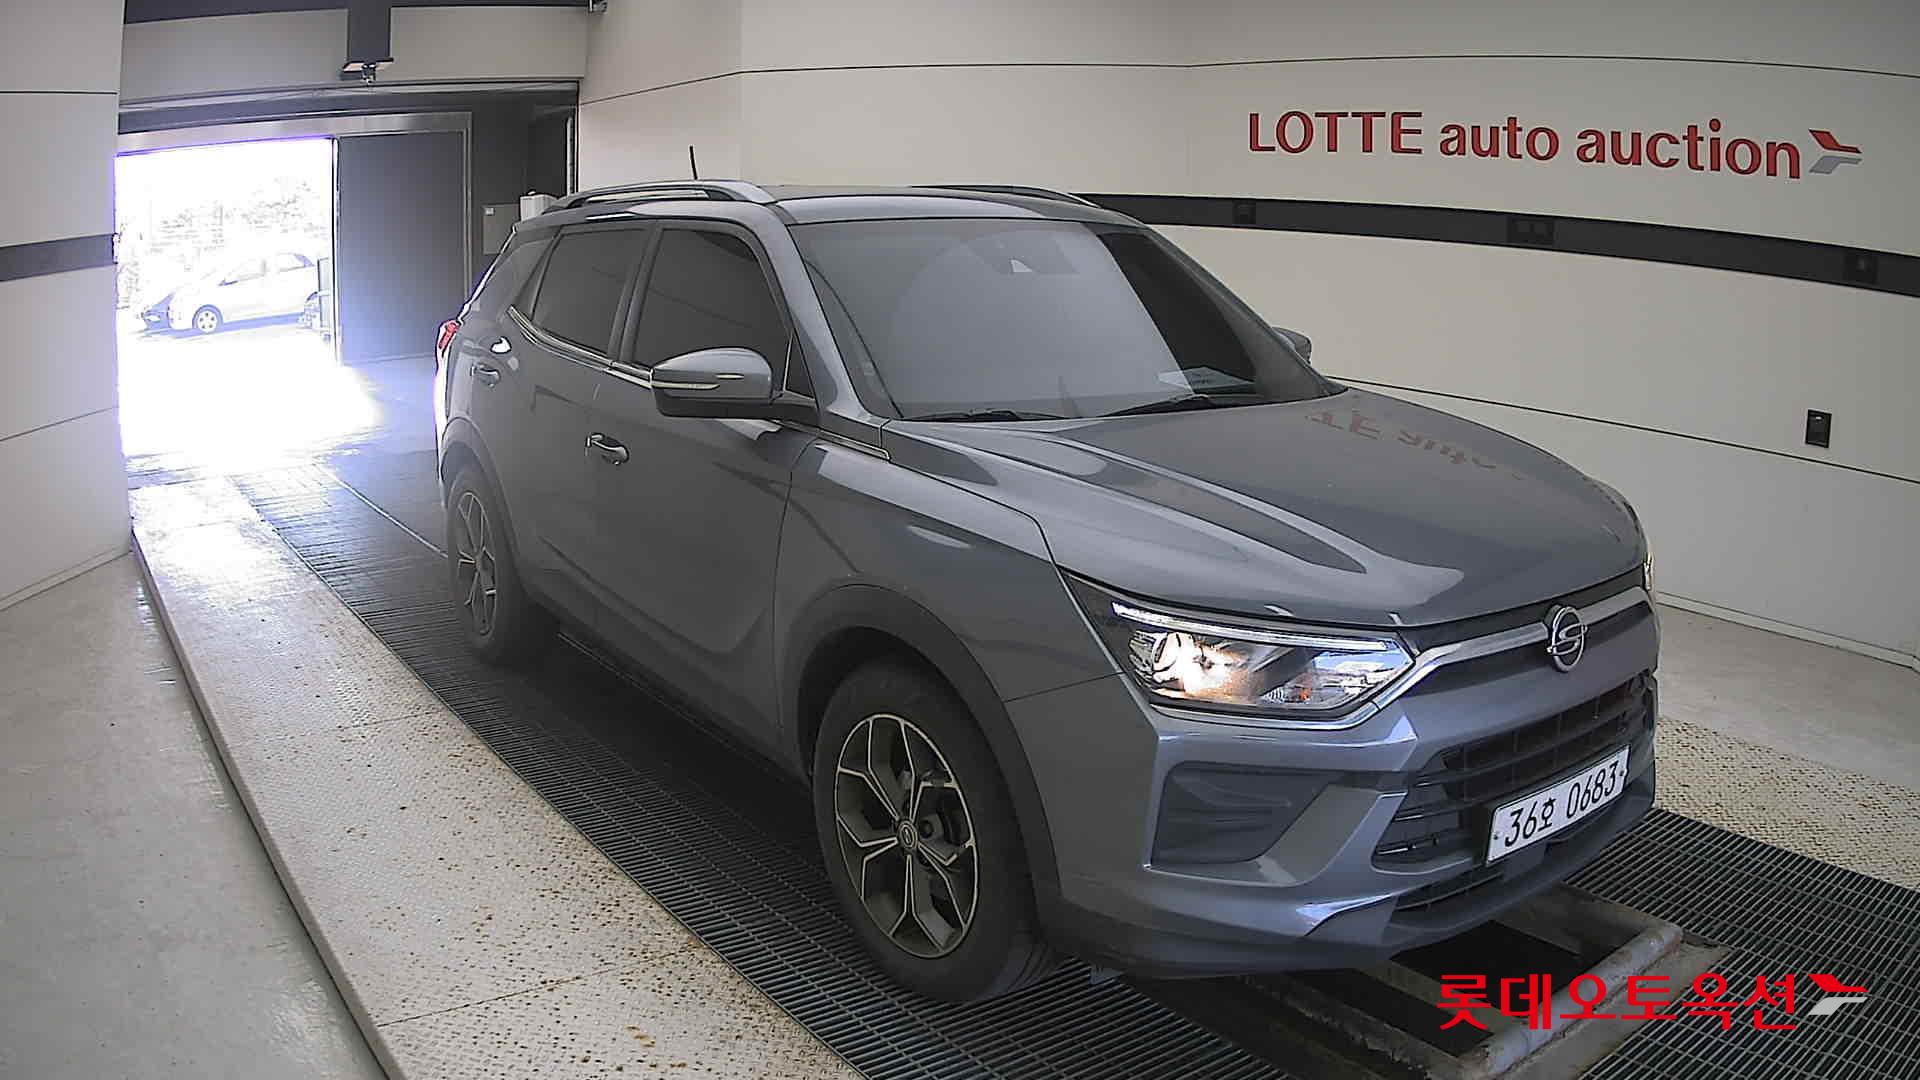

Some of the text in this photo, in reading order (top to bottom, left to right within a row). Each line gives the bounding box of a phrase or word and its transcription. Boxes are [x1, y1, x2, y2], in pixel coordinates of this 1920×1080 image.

[1248, 110, 1802, 179] LOTTE auto auction
[1505, 760, 1619, 847] 36호 0683
